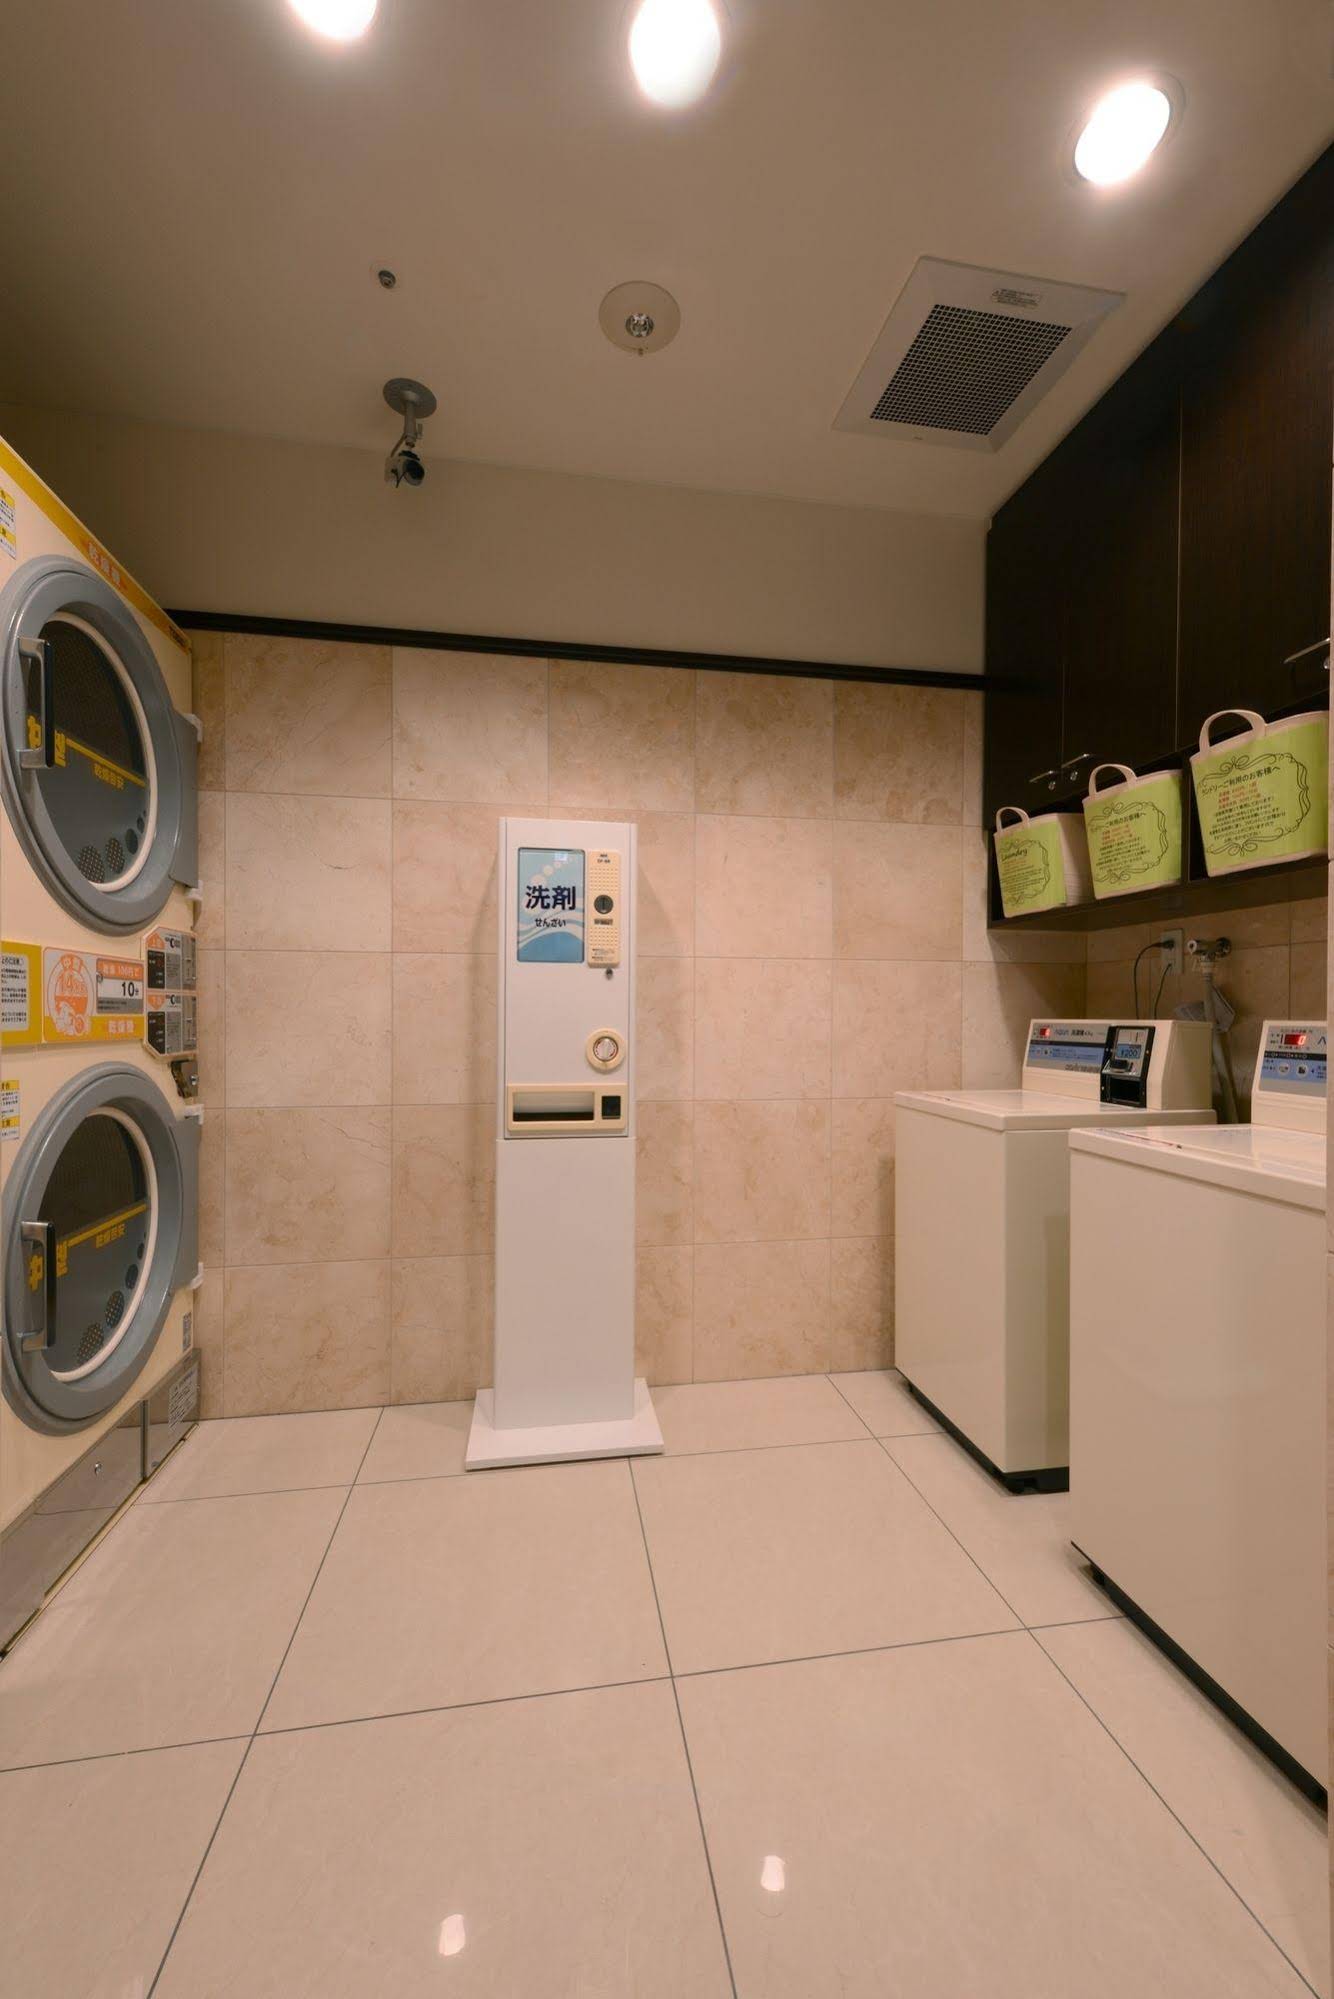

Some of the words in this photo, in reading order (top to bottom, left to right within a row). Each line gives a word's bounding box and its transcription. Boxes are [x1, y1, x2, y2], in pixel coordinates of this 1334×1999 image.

[525, 884, 576, 911] 洗剤
[534, 917, 567, 928] せんざい
